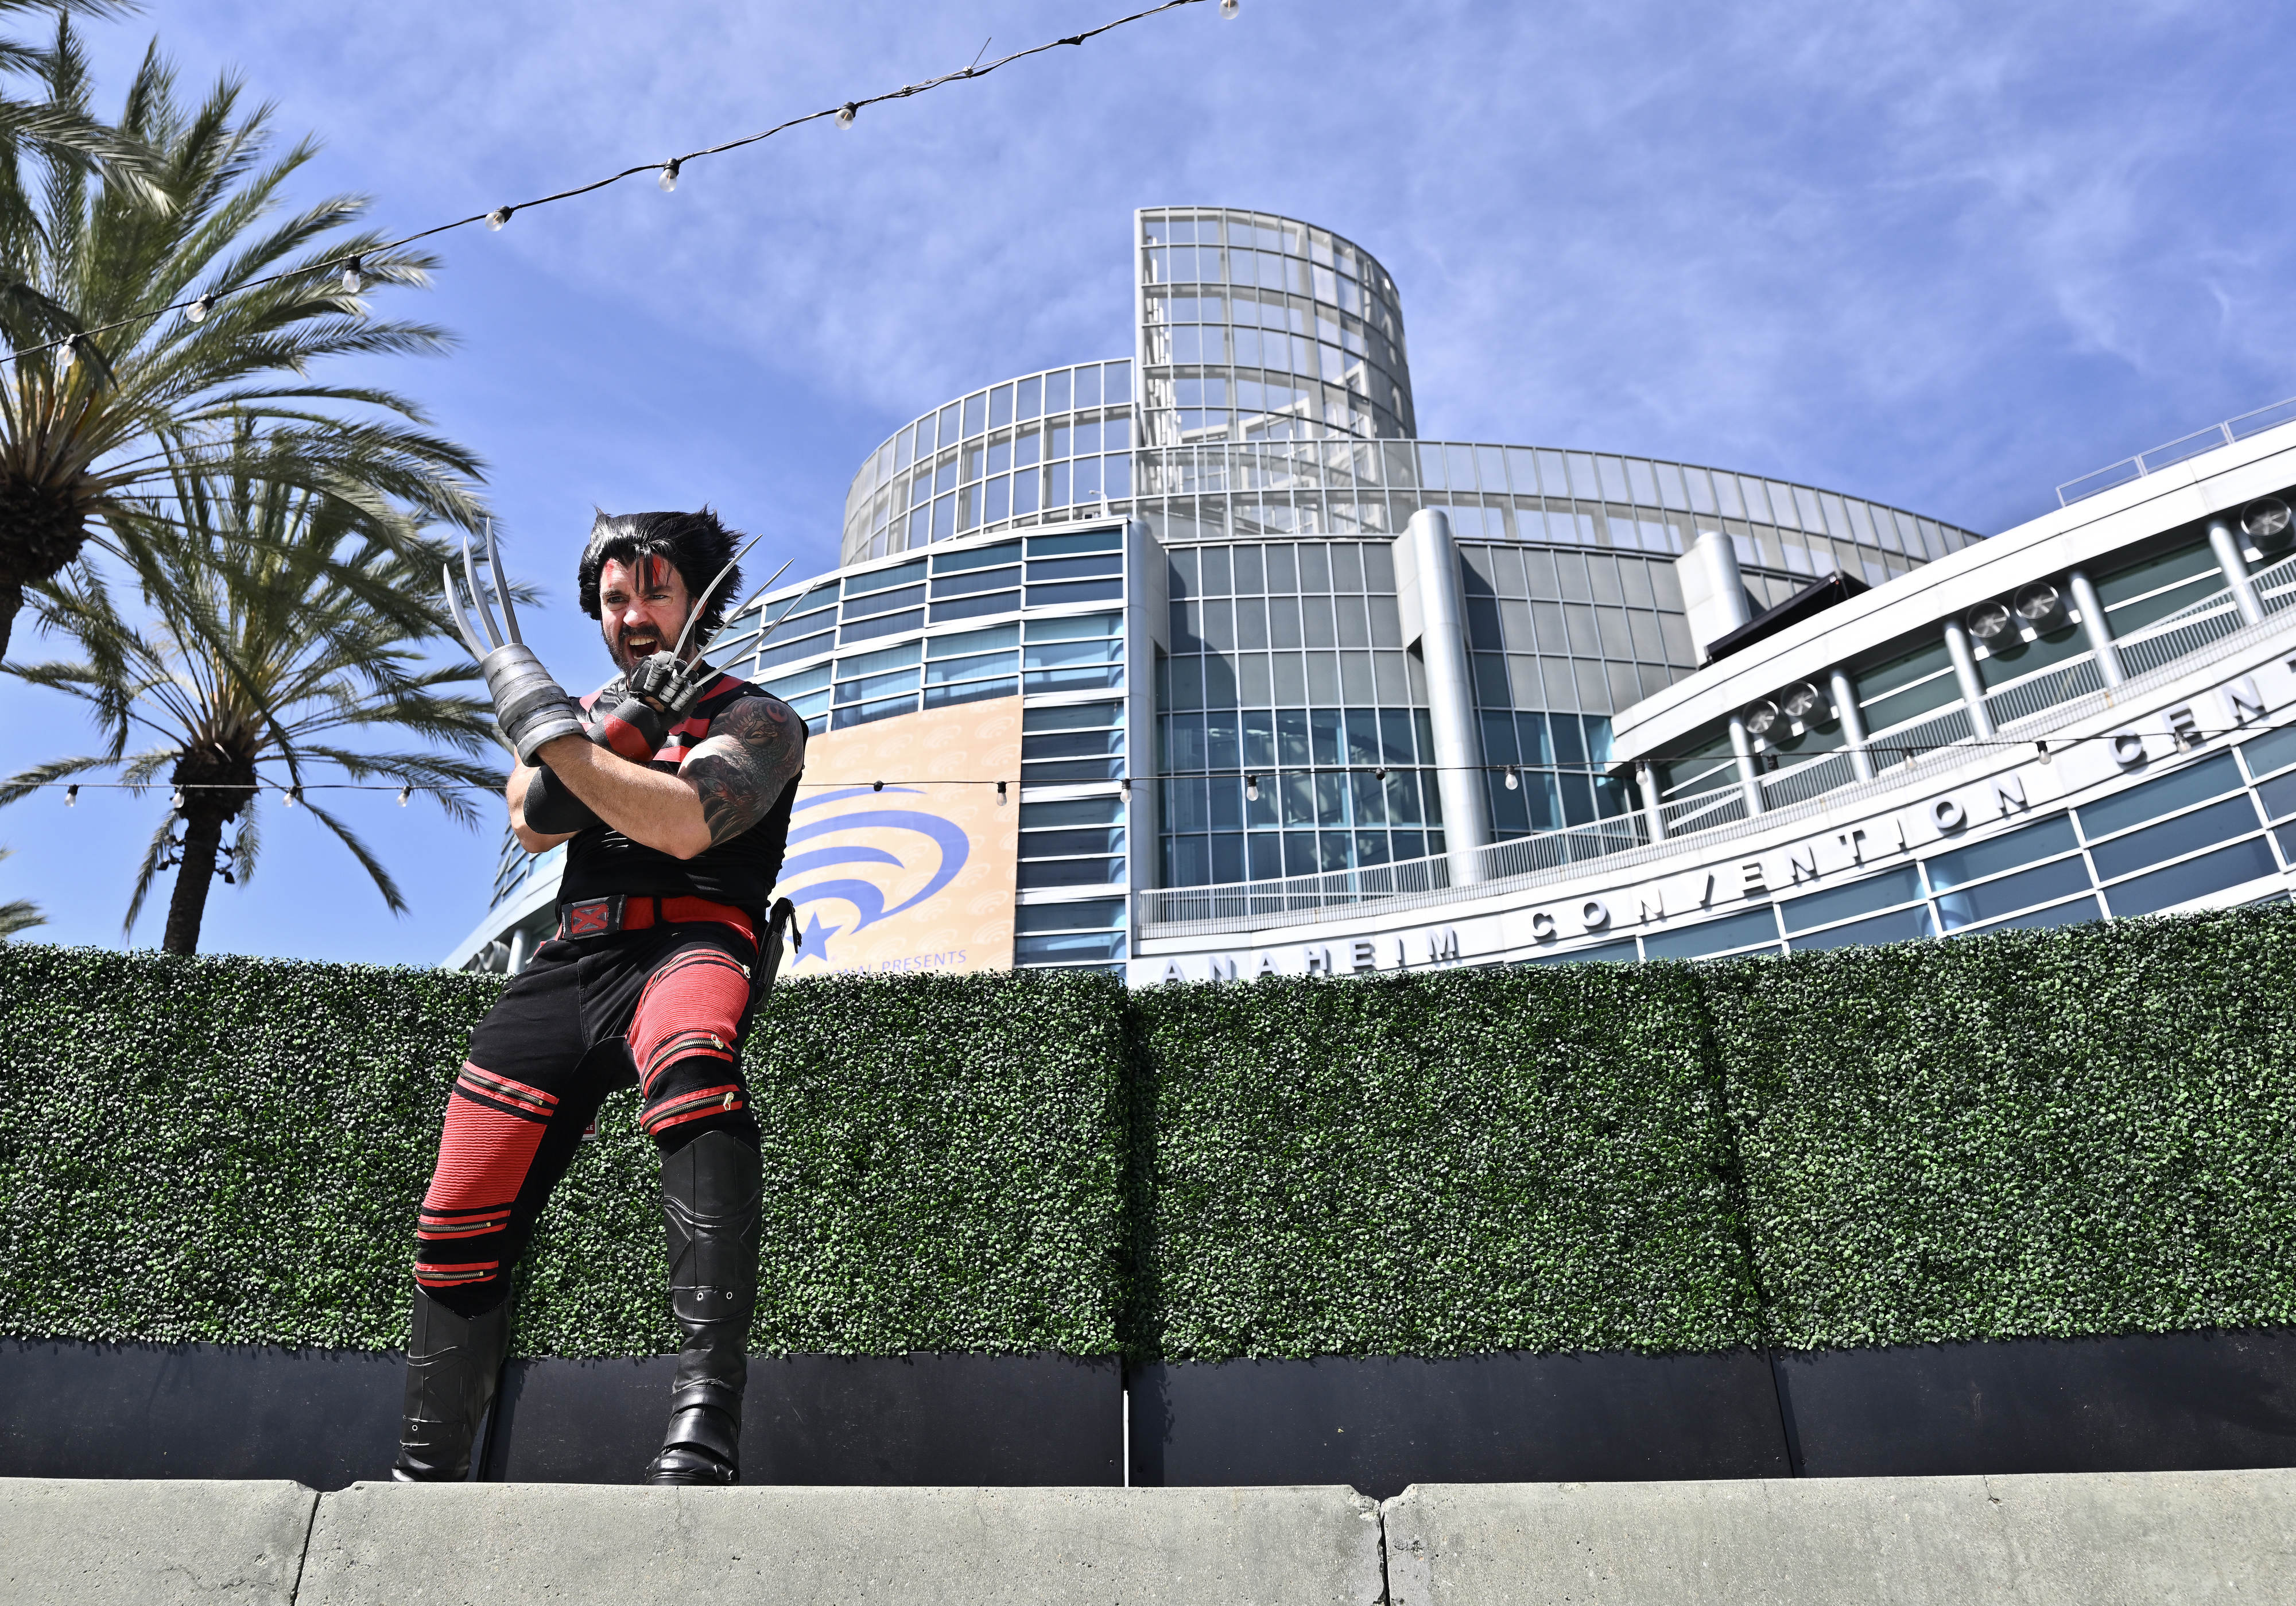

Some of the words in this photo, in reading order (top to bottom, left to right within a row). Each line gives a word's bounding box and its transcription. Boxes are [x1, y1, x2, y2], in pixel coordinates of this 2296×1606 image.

[1159, 925, 1460, 984] ANAHEIM
[1529, 771, 2030, 941] CONVENTION
[2108, 652, 2296, 766] CEN
[881, 949, 967, 973] PRESENTS
